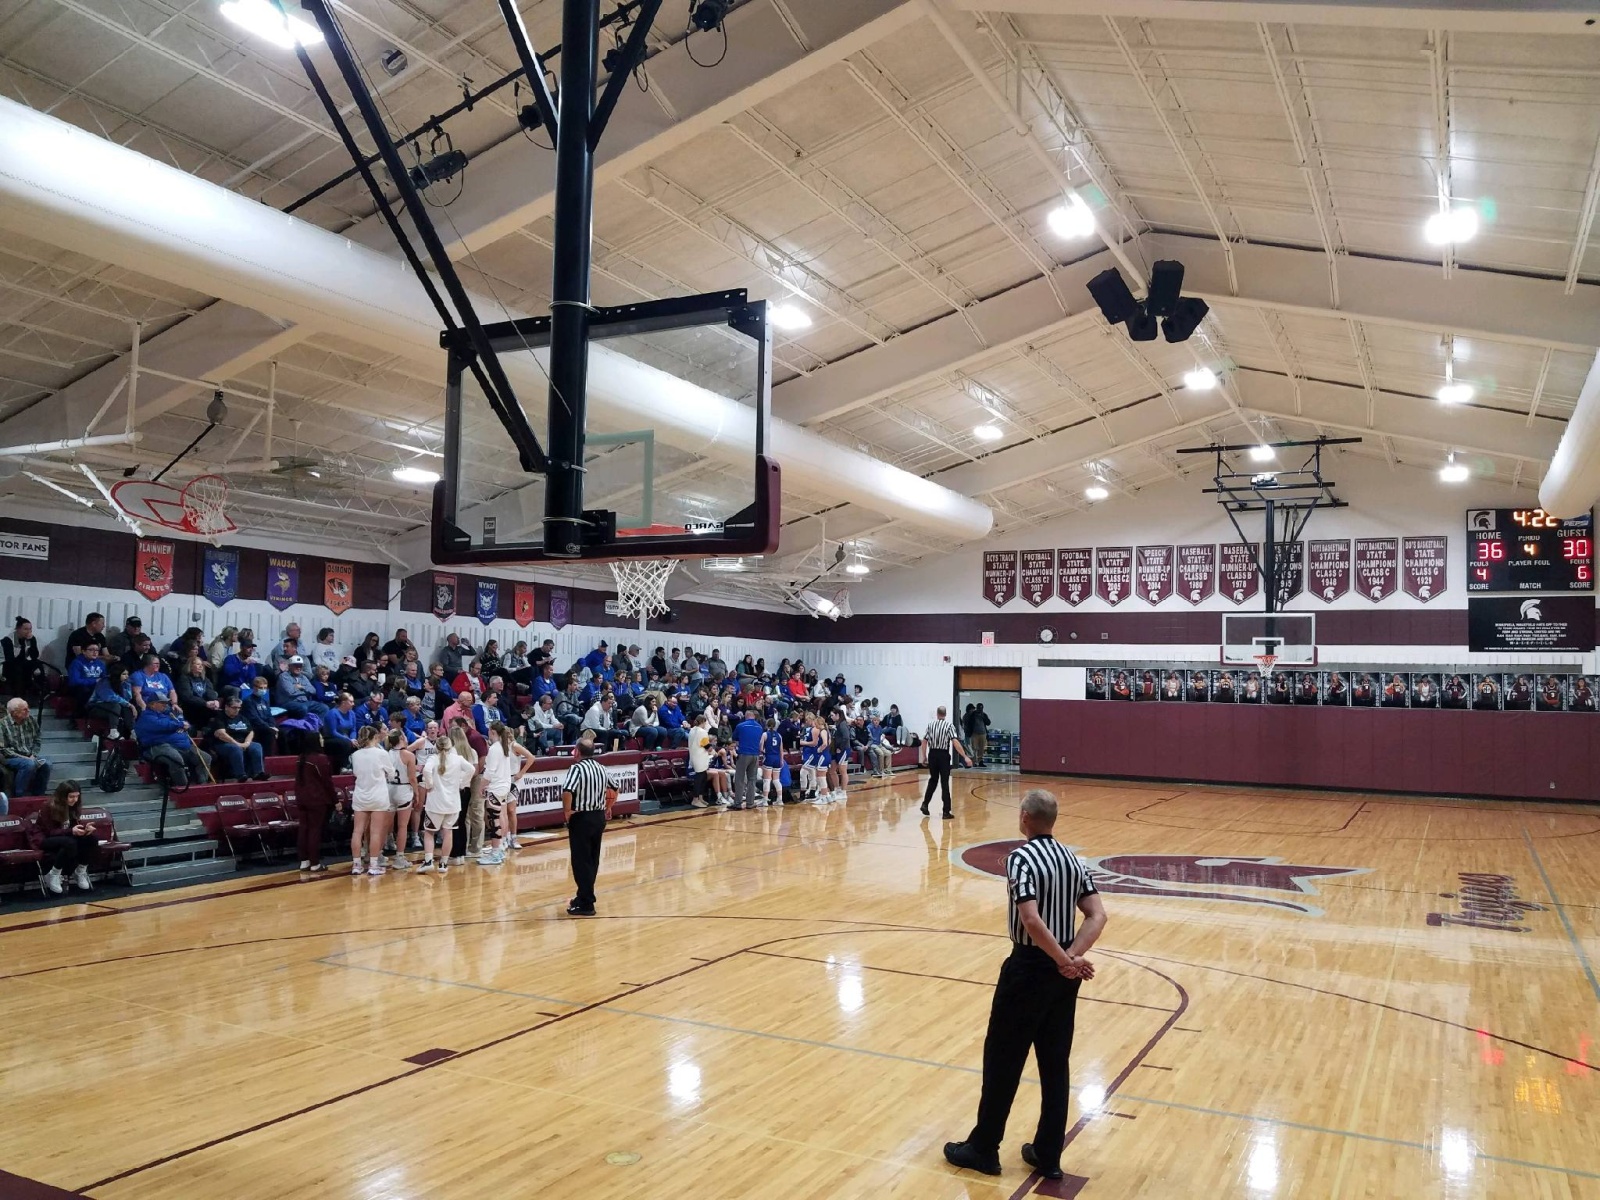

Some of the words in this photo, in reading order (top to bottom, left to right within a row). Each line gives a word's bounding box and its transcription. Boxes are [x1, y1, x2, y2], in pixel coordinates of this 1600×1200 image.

[1476, 532, 1501, 540] HOME
[1557, 529, 1587, 538] GUEST
[23, 543, 47, 552] FANS
[139, 542, 172, 554] PLAINVIEW
[1322, 543, 1348, 552] BASKETBALL
[1369, 542, 1395, 550] BASKETBALL
[1524, 544, 1535, 556] 4
[1564, 540, 1587, 557] 30
[1144, 549, 1166, 557] SPEECH
[1182, 548, 1211, 556] BASEBALL
[1224, 546, 1255, 555] BASEBAL
[1414, 550, 1435, 558] STATE
[1479, 543, 1503, 559] 36
[1230, 555, 1249, 563] STATE
[1320, 552, 1340, 560] STATE
[1366, 551, 1386, 559] STATE
[269, 558, 297, 569] WAUSA
[1146, 557, 1164, 565] STATE
[1187, 556, 1205, 564] STATE
[1357, 560, 1396, 568] CHAMPIONS
[1405, 559, 1444, 567] CHAMPIONS
[1139, 565, 1170, 573] RUNNER-UP
[1180, 565, 1213, 573] CHAMPIONS
[1221, 563, 1257, 572] RUNNER-UP
[1310, 561, 1349, 569] CHAMPIONS
[327, 564, 352, 575] OSMOND
[1412, 568, 1432, 576] CLASS
[1578, 566, 1587, 580] 6
[986, 570, 1015, 578] RUNNER-UP
[1121, 574, 1130, 582] C2
[1141, 574, 1159, 582] CLASS
[1227, 572, 1247, 580] CLASS
[1316, 570, 1337, 578] CLASS
[1477, 568, 1487, 580] 4
[1025, 576, 1041, 584] CLASS
[138, 582, 170, 592] PIRATES
[772, 738, 777, 746] 5
[524, 777, 551, 785] Welcome
[517, 785, 563, 806] WAKEFIEL
